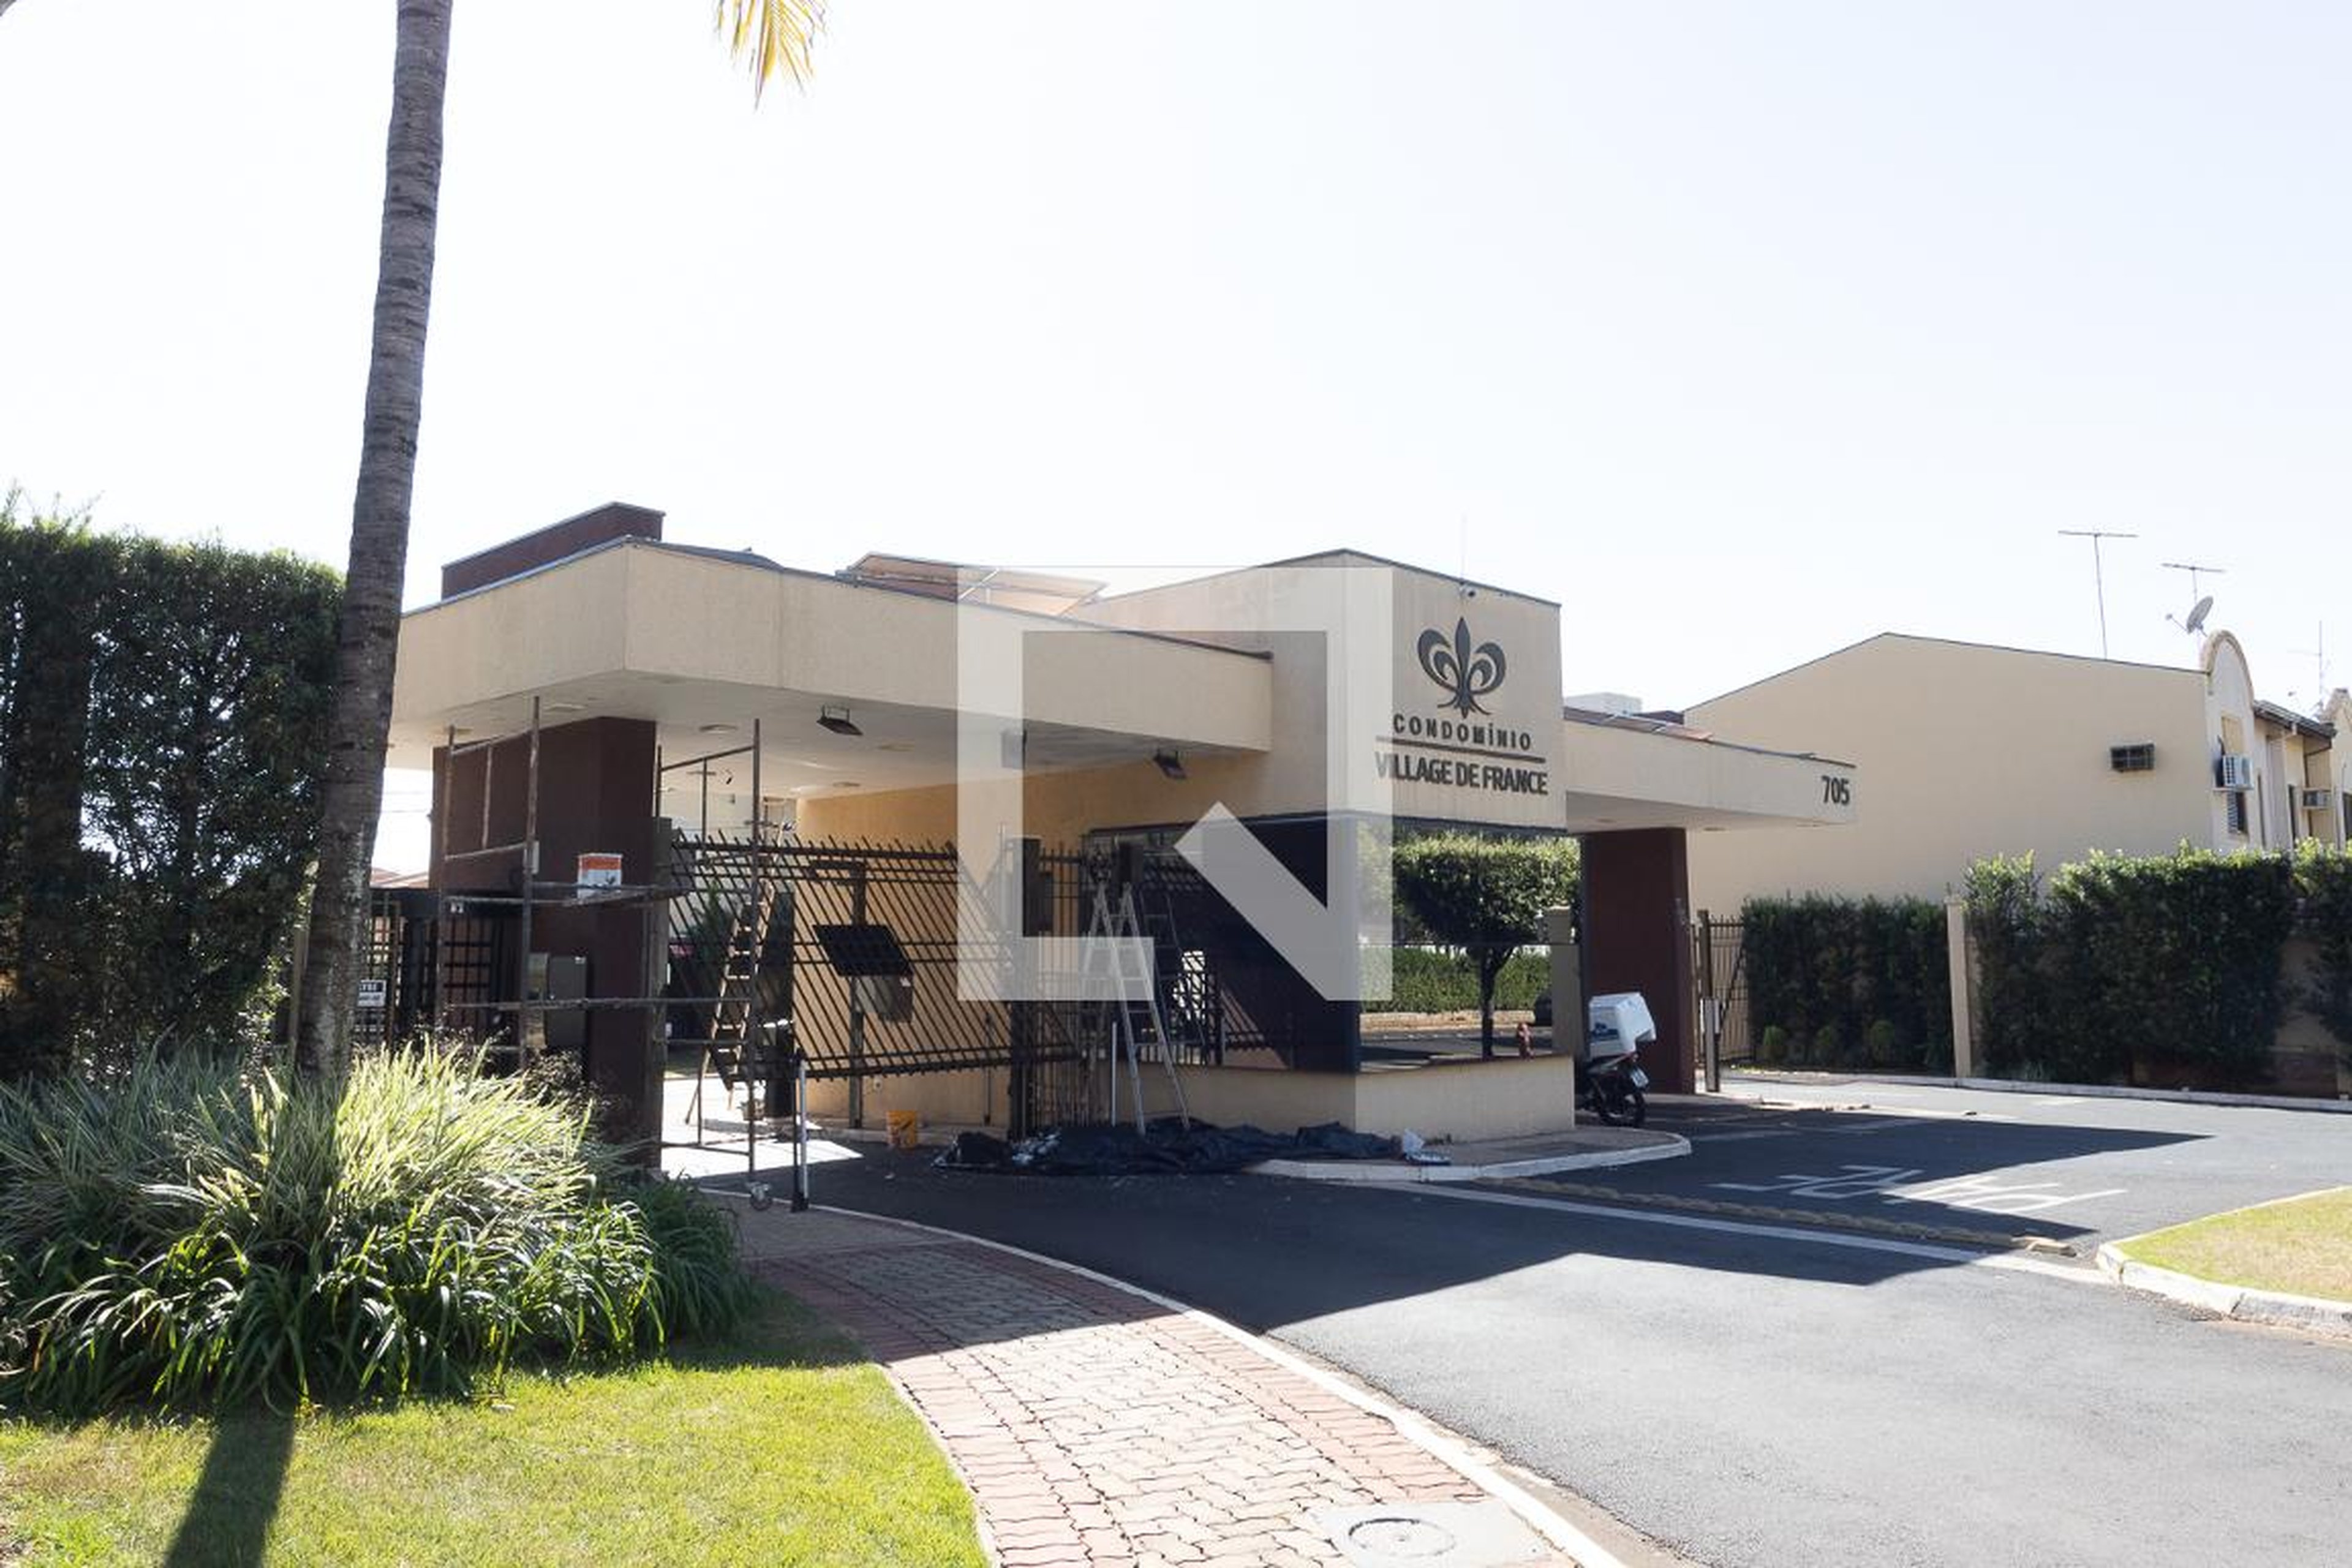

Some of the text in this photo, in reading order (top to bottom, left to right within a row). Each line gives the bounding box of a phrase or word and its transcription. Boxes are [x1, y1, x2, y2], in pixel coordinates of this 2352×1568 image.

[1393, 713, 1532, 751] CONDOMÍNIO
[1374, 751, 1548, 796] VILLAGE DE FRANCE
[1821, 775, 1849, 805] 705
